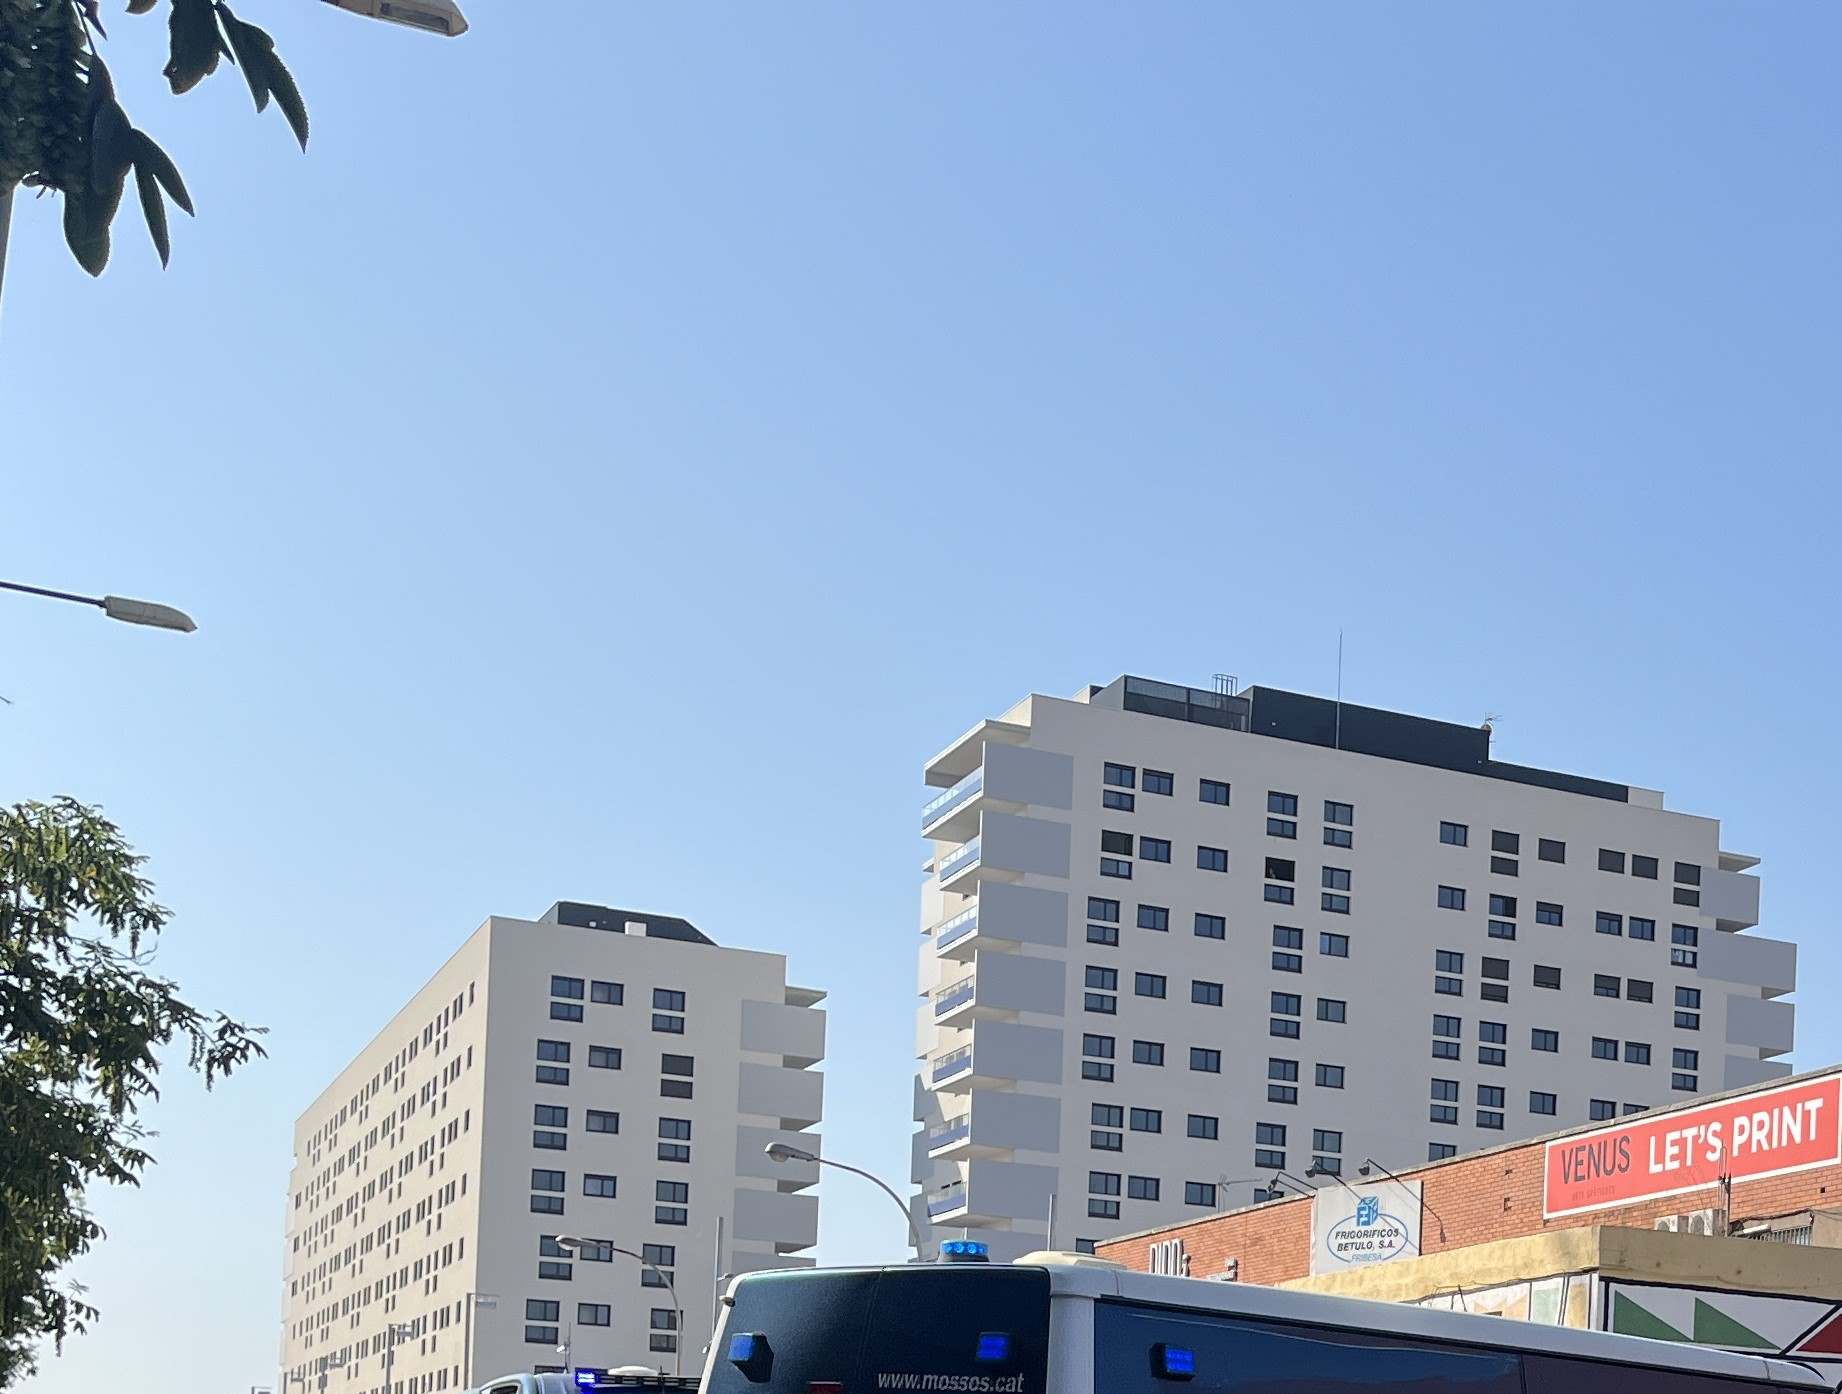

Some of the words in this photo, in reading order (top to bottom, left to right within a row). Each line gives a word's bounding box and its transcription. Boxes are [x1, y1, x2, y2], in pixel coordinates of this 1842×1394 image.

[1561, 1134, 1631, 1184] VENUS
[1648, 1121, 1724, 1174] LET'S
[1731, 1097, 1824, 1157] PRINT
[1335, 1228, 1399, 1240] FRIGORIFICOS
[878, 1373, 1024, 1393] www.mossos.cat
